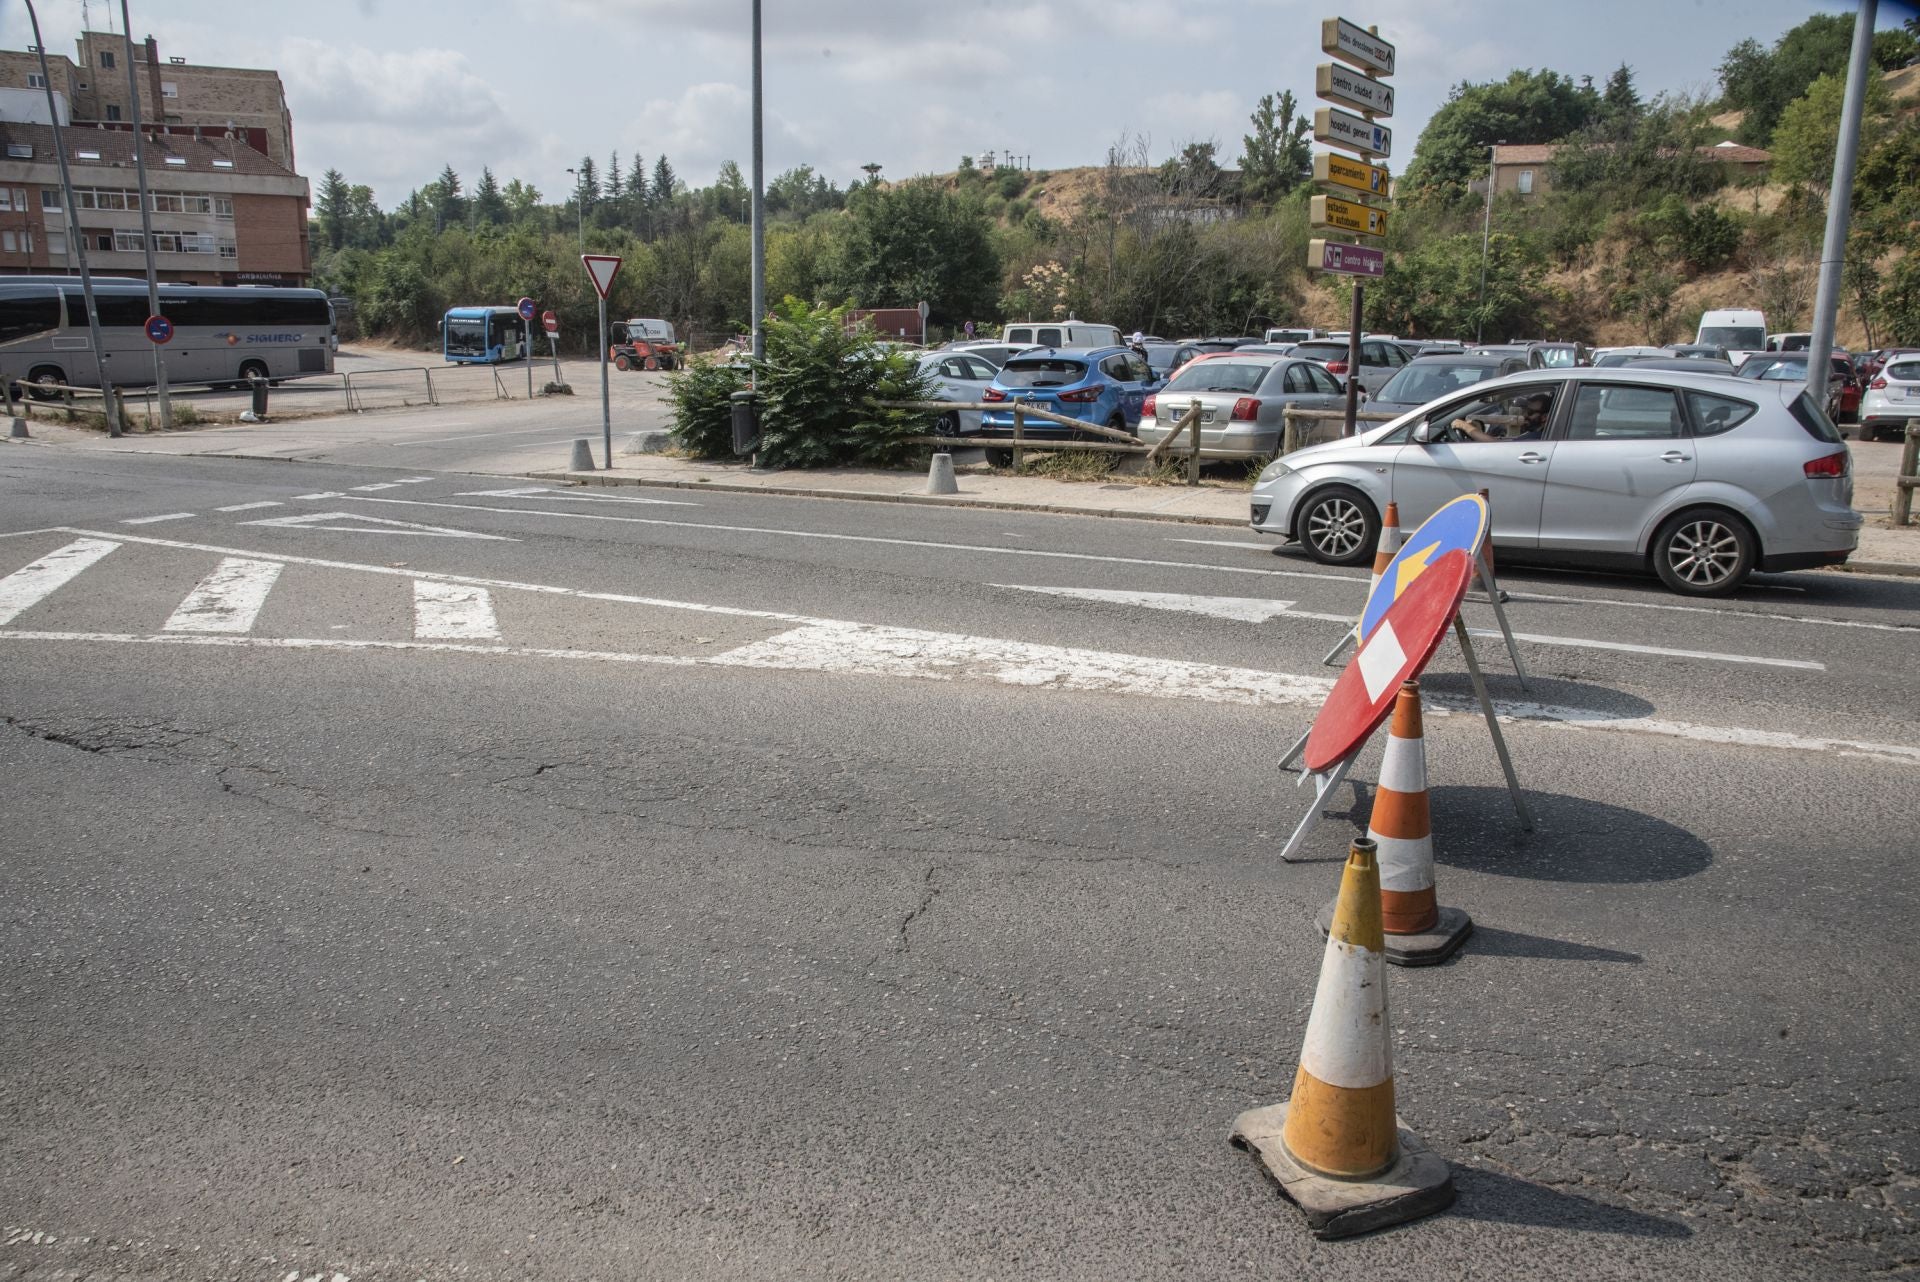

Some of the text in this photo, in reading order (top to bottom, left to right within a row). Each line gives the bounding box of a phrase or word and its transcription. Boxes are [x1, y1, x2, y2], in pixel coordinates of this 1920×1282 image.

[1333, 76, 1372, 100] centro ciudad
[1331, 119, 1371, 140] hospital general
[1330, 163, 1366, 182] aparcamiento
[1336, 216, 1360, 228] autobuses
[1345, 256, 1361, 266] centro
[246, 333, 302, 343] SIGUERO
